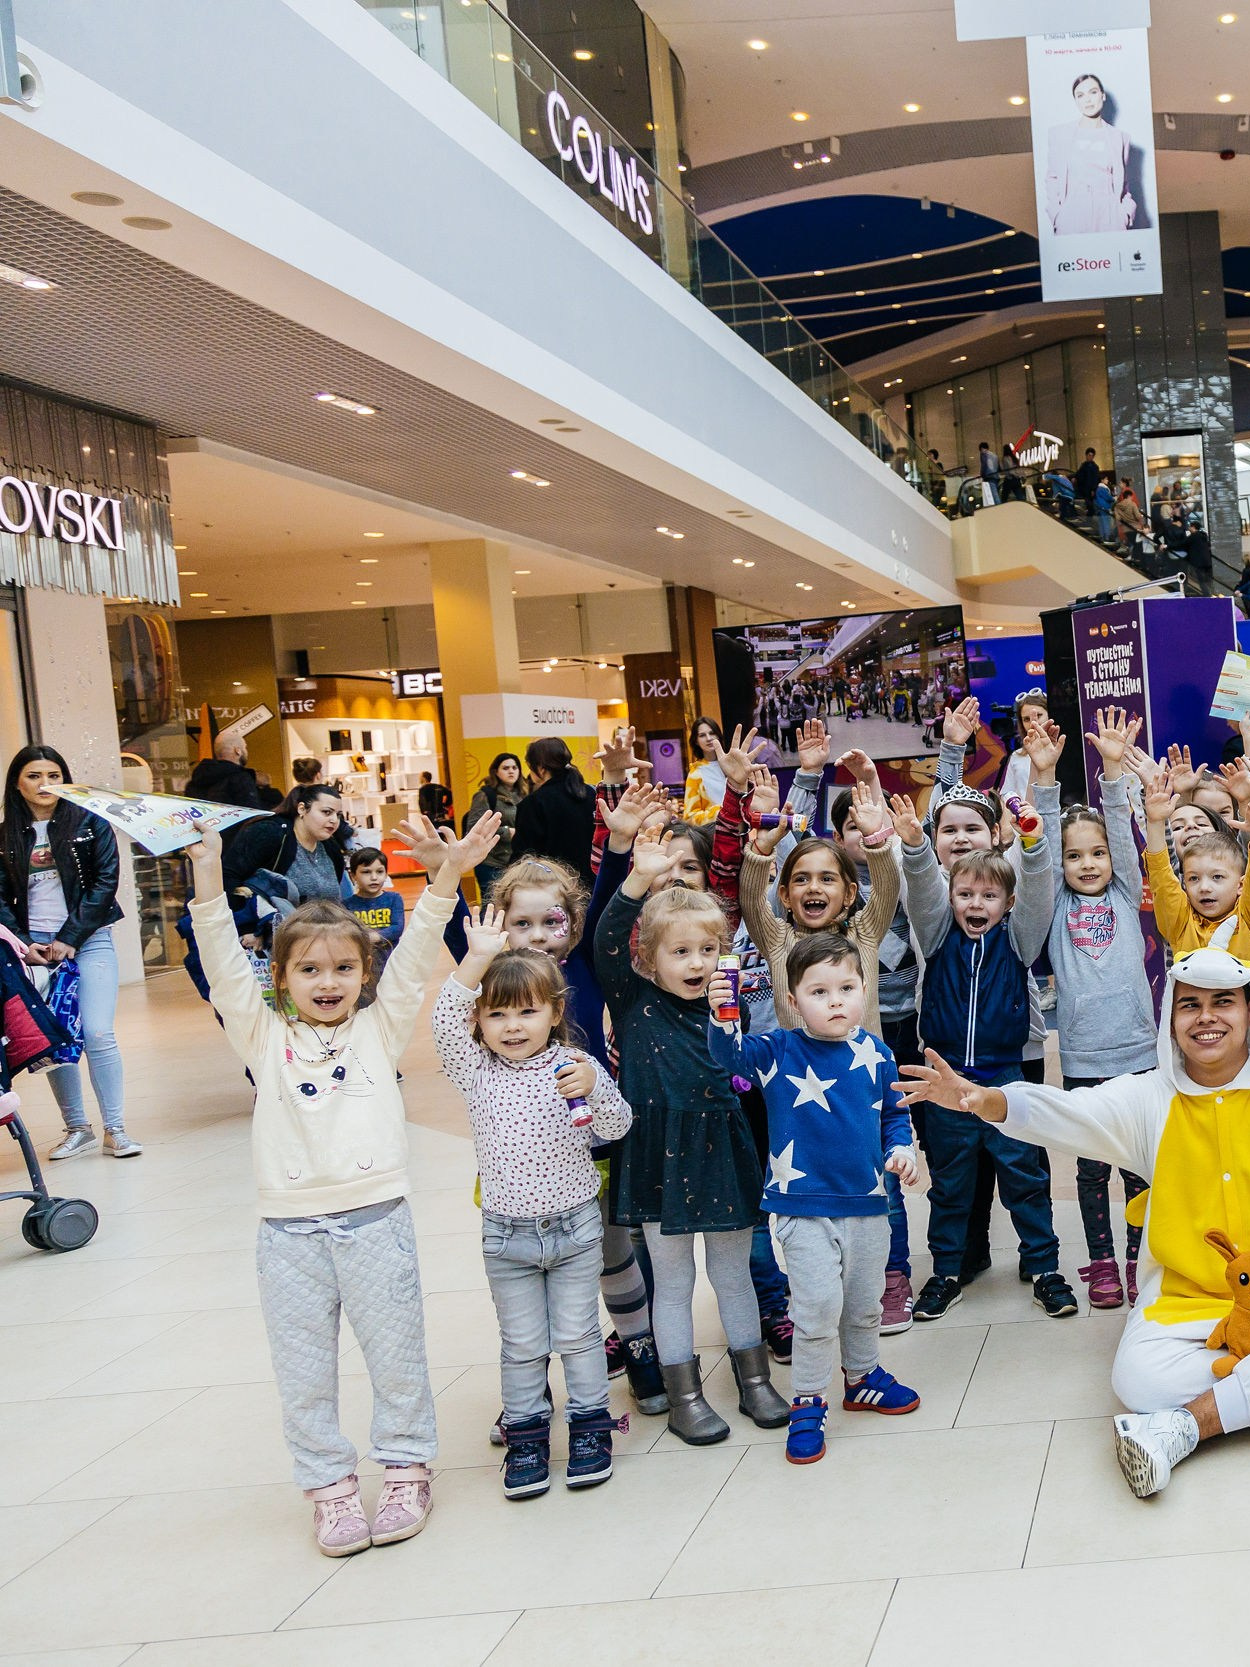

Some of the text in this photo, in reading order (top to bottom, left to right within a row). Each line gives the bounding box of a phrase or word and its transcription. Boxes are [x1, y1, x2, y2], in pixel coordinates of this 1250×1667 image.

[547, 91, 653, 235] COLIN'S
[1057, 257, 1111, 272] re:Store
[1086, 641, 1134, 664] ПУТЕШЕСТВИЕ
[1099, 658, 1130, 680] СТРАНУ
[1084, 677, 1142, 700] ТЕЛЕВИДЕНИЯ
[532, 705, 567, 724] swatch
